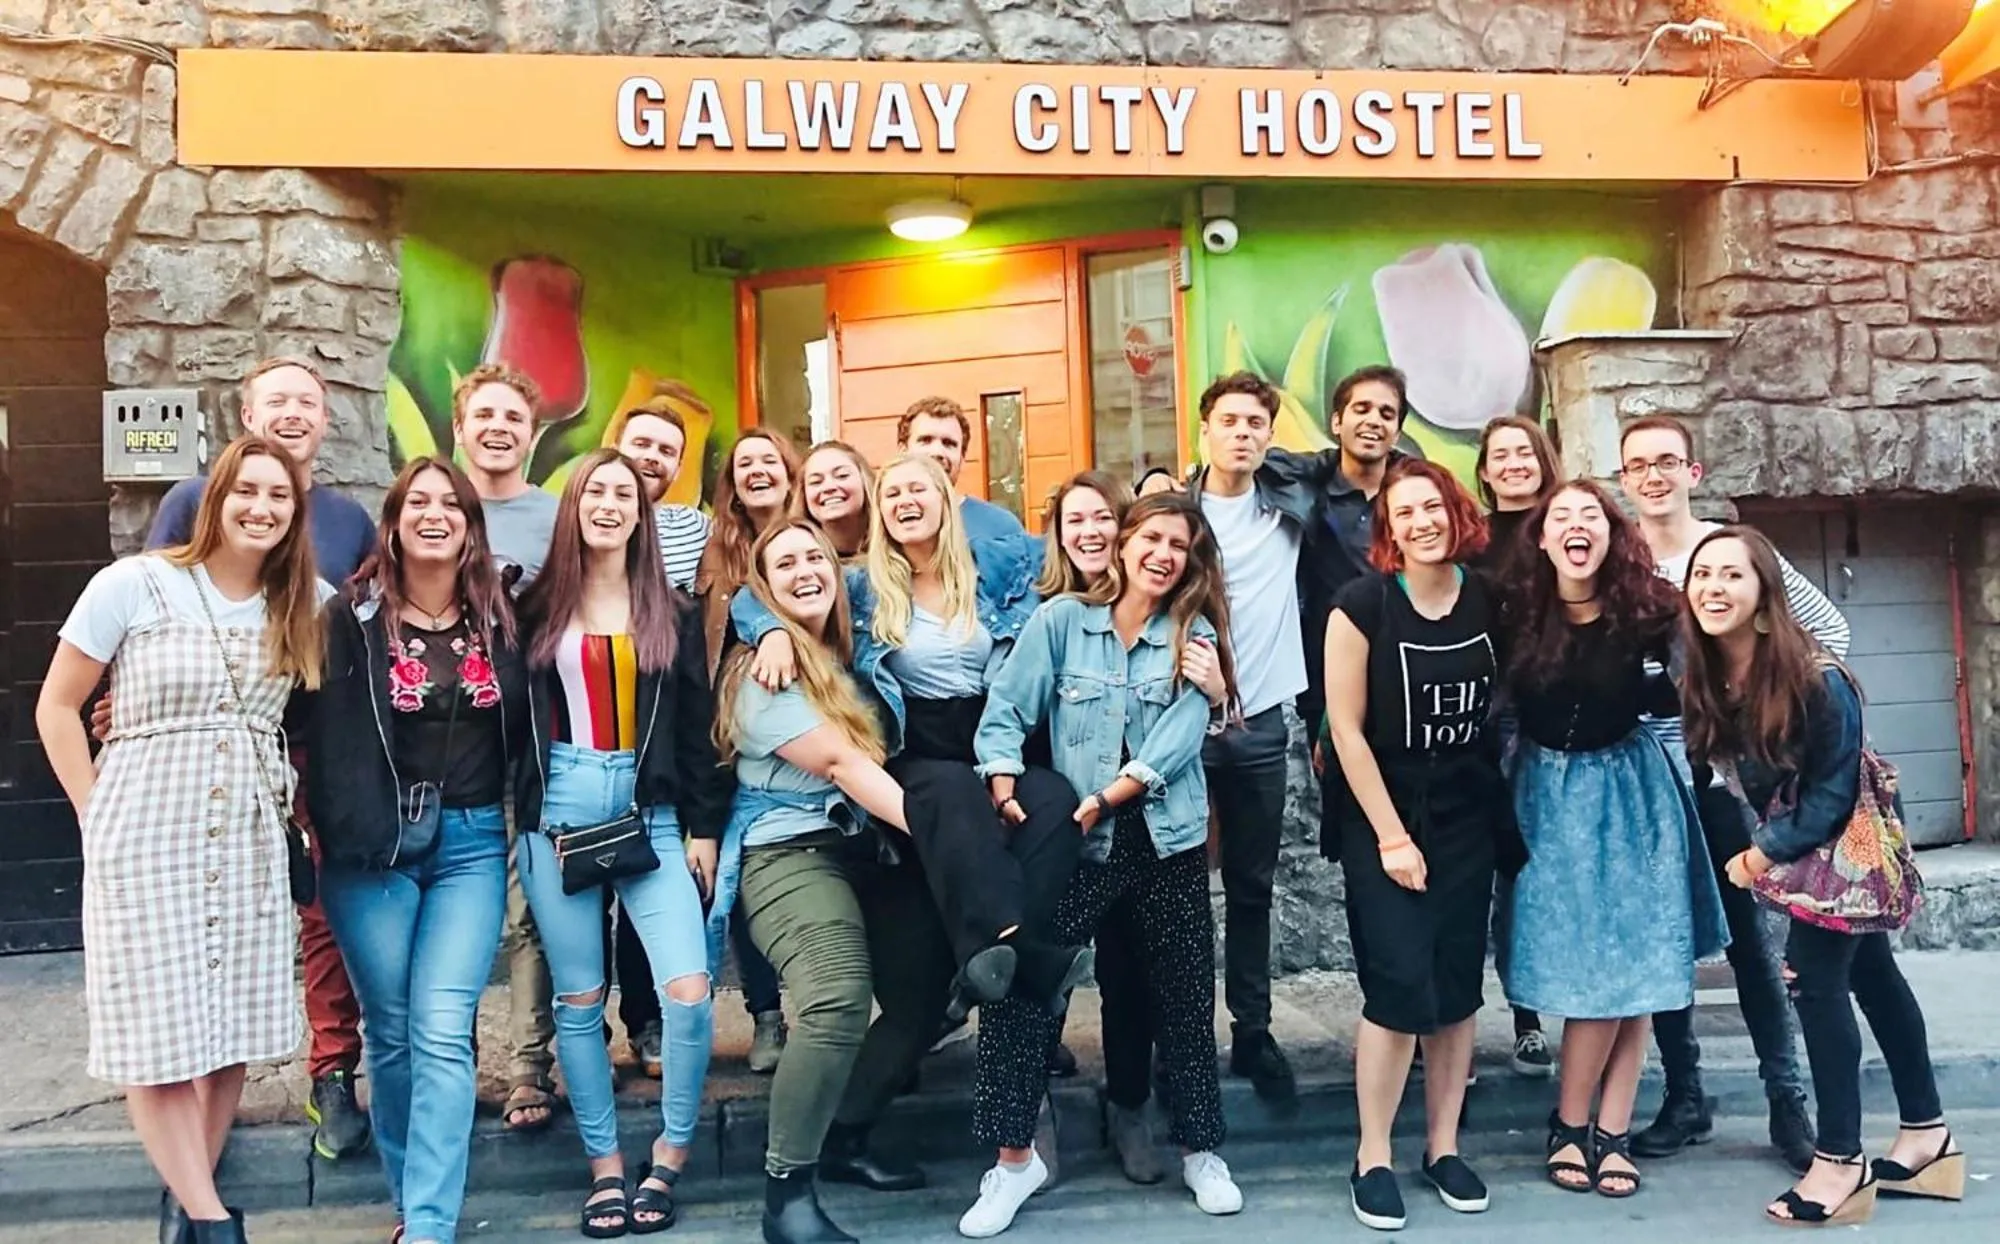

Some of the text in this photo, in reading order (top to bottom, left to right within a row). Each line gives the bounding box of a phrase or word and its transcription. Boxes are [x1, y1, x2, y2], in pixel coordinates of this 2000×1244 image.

[616, 76, 1543, 159] GALWAY CITY HOSTEL
[126, 431, 177, 447] RIFREDI
